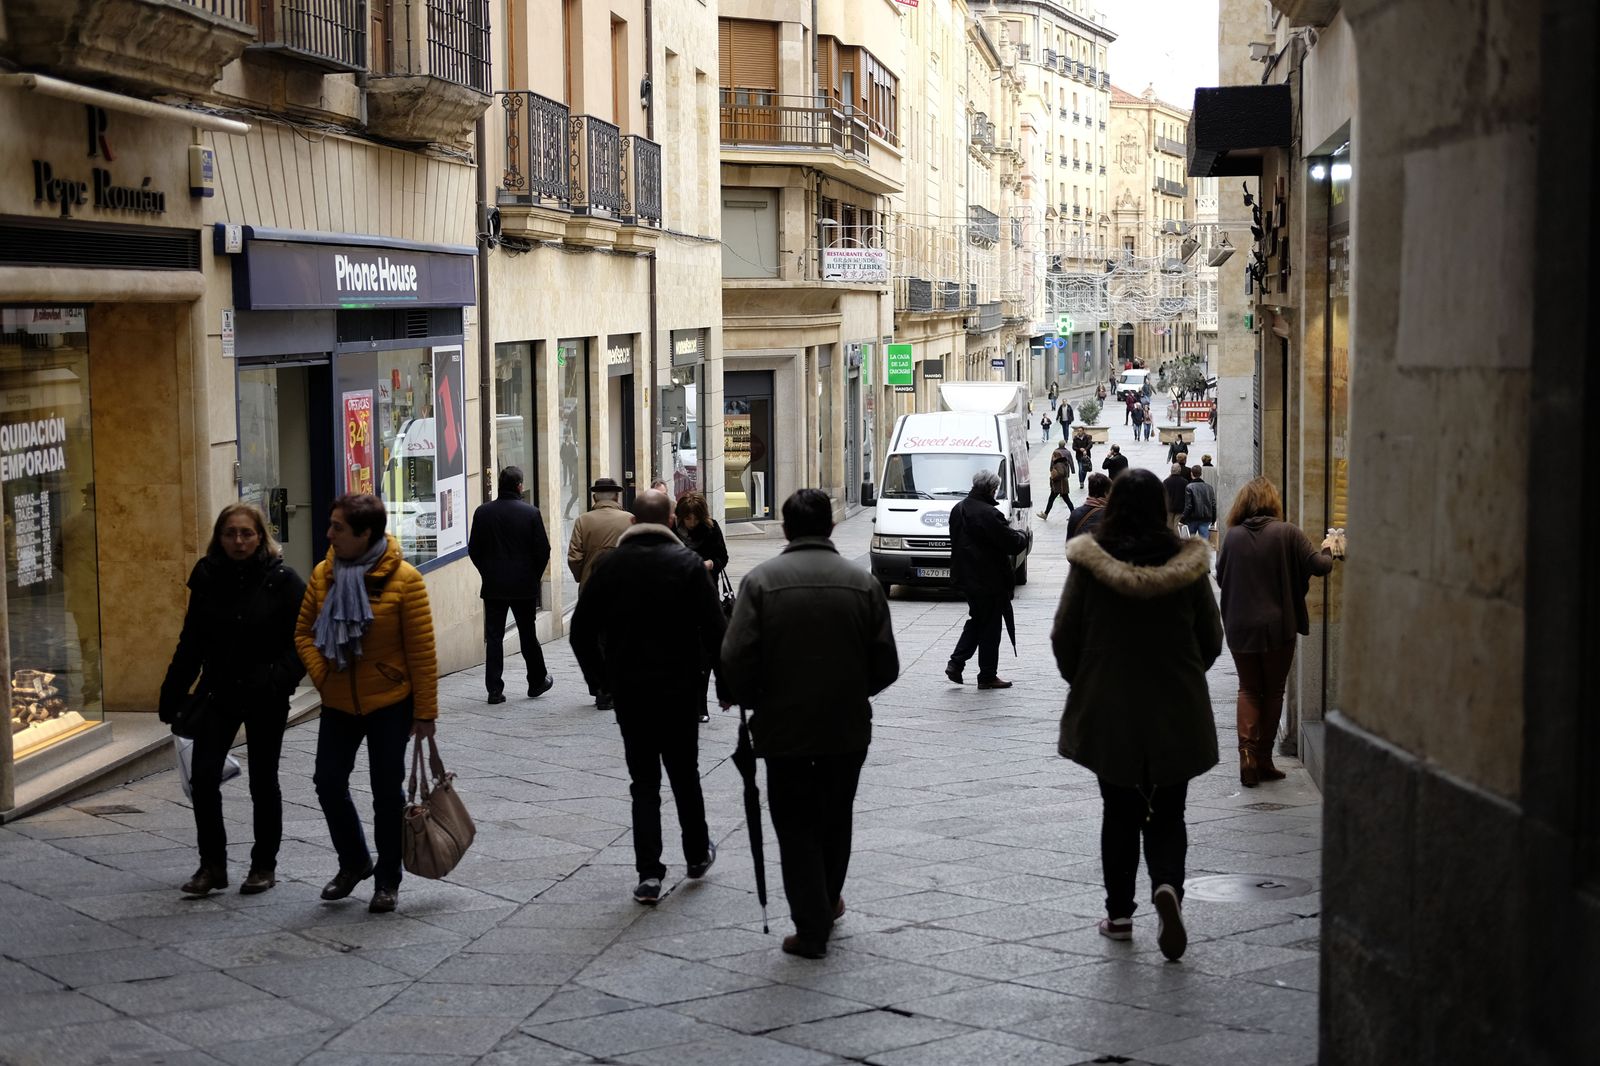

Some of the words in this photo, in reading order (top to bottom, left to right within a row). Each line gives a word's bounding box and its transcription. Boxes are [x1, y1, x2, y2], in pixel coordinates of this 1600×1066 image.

[86, 104, 117, 162] R
[32, 160, 88, 218] Pepe
[92, 168, 166, 214] Román
[0, 412, 66, 452] QUIDACIÓN
[904, 436, 949, 449] Sweet
[949, 436, 992, 448] soul.es
[0, 447, 66, 481] EMPORADA
